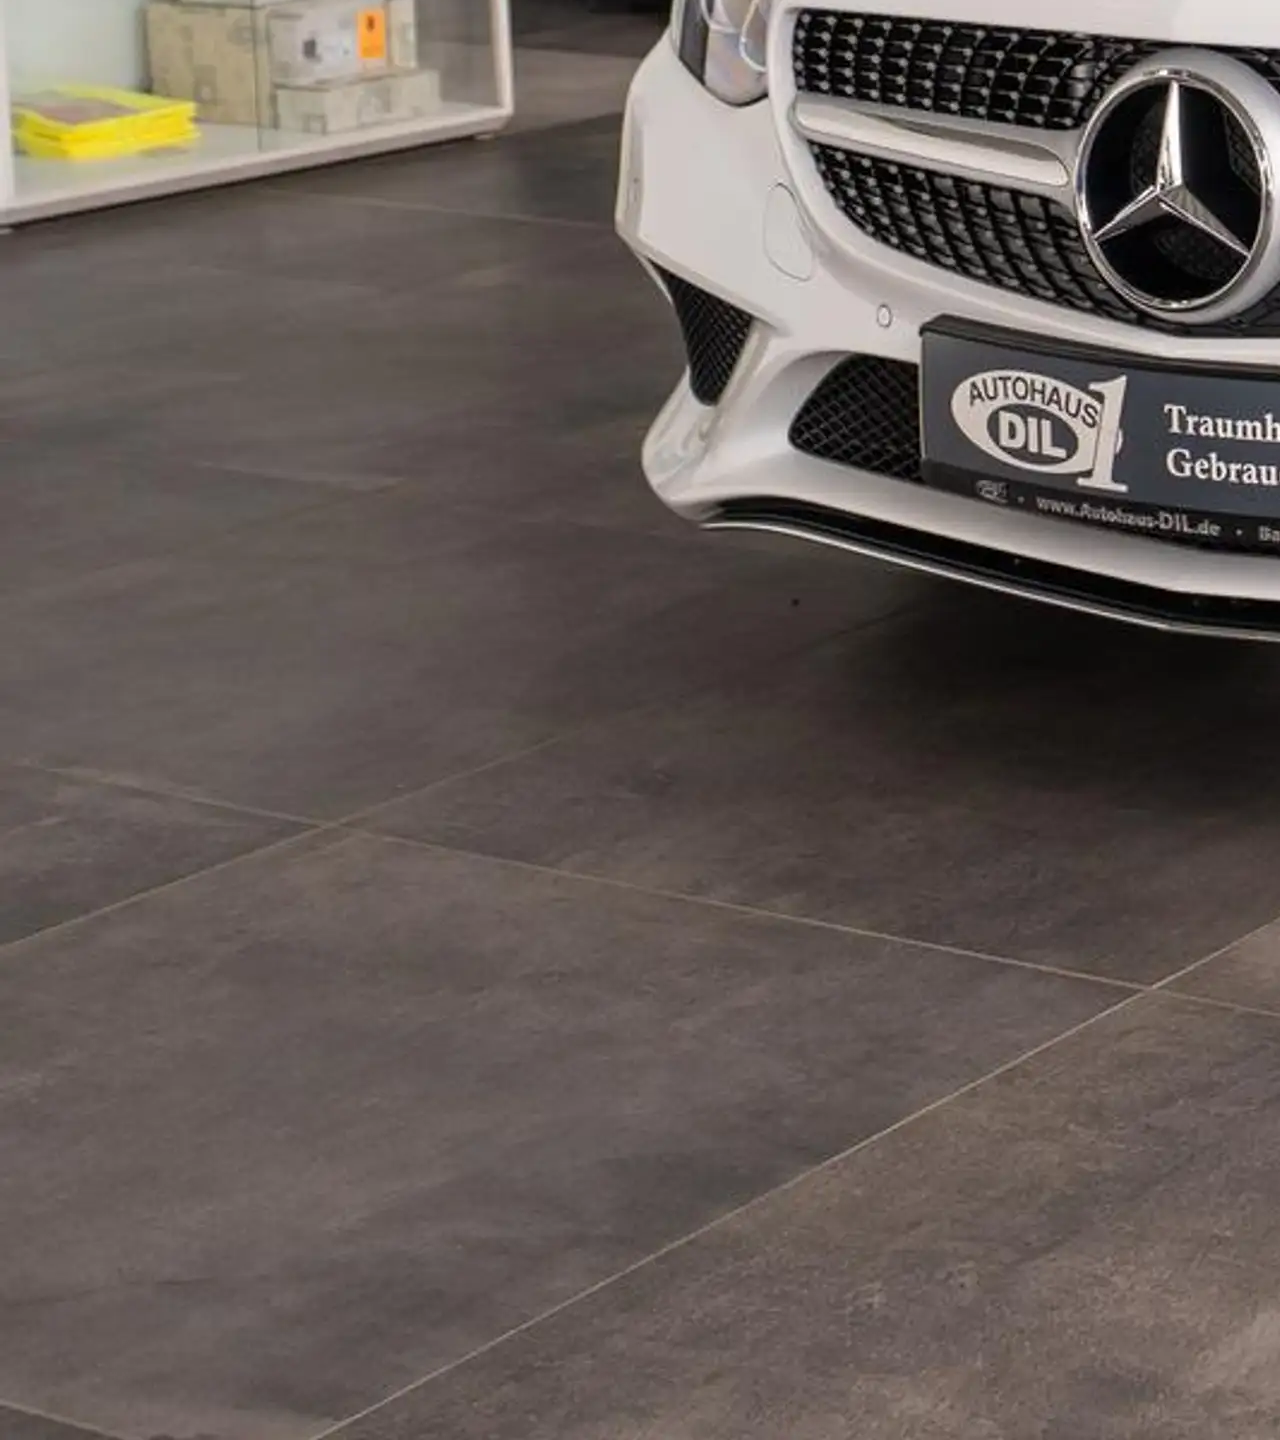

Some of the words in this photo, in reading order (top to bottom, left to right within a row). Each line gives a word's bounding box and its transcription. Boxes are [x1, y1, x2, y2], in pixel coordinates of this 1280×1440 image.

[969, 376, 1099, 429] AUTOHAUS
[999, 410, 1068, 459] DIL
[1036, 496, 1221, 537] www.Autohaus-DIL.de
